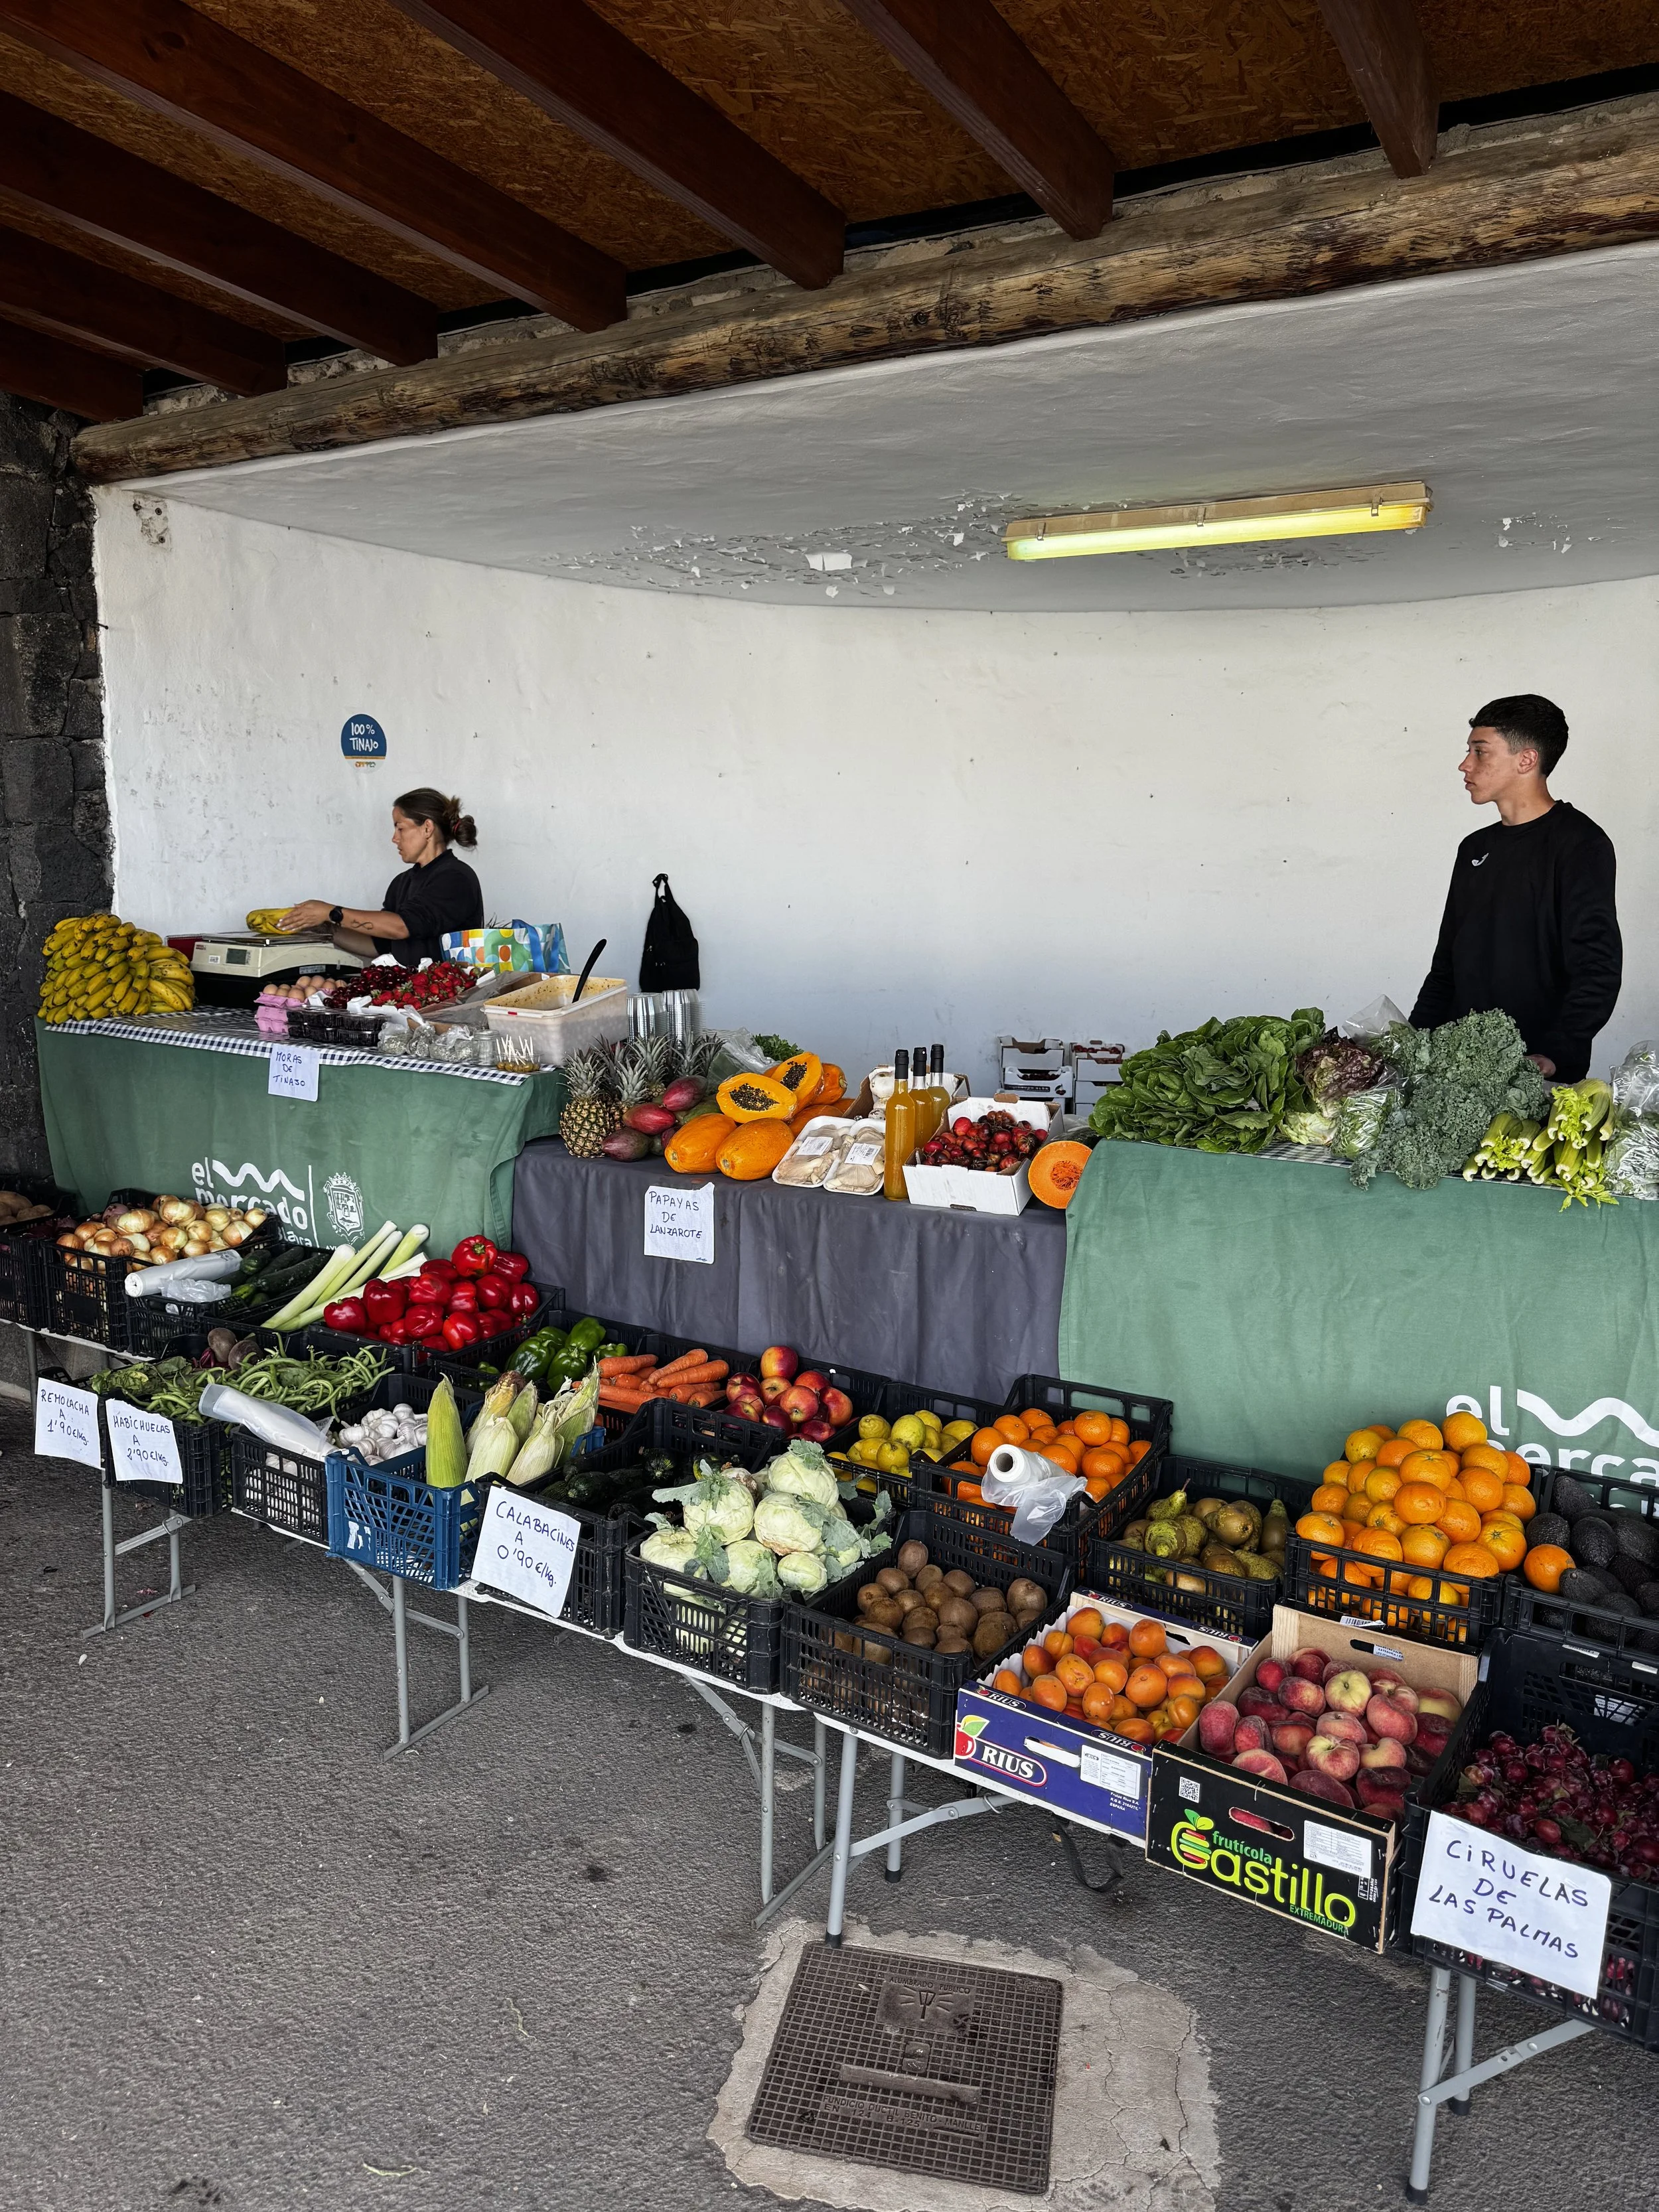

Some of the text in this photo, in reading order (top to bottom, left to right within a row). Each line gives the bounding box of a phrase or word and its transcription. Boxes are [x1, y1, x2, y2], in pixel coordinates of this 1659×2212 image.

[349, 737, 379, 752] TINAJO
[275, 1051, 303, 1064] MORAS
[282, 1063, 293, 1072] DE
[191, 1157, 214, 1189] el
[648, 1191, 699, 1211] PAPAYAS
[661, 1211, 677, 1223] DE
[650, 1223, 703, 1239] LANZAROTE
[40, 1388, 90, 1416] REMOLACHA
[59, 1408, 66, 1421] A
[1445, 1384, 1510, 1436] el
[133, 1434, 141, 1446] A
[514, 1530, 524, 1546] A
[1098, 1596, 1128, 1609] RIUS
[1198, 1626, 1229, 1639] RIUS
[988, 1693, 1021, 1708] RIUS
[1098, 1732, 1132, 1747] RIUS
[981, 1745, 1034, 1779] RIUS
[1212, 1830, 1272, 1866] frutícola
[1472, 1878, 1517, 1905] DE
[1289, 1904, 1349, 1936] EXTREMADURA
[1428, 1884, 1579, 1958] LAS PALMAS
[889, 1976, 934, 1989] ALUMBRADO
[824, 2104, 840, 2112] EN
[852, 2108, 871, 2119] 124
[868, 2103, 899, 2116] DUCTIL
[904, 2112, 938, 2124] BENITO
